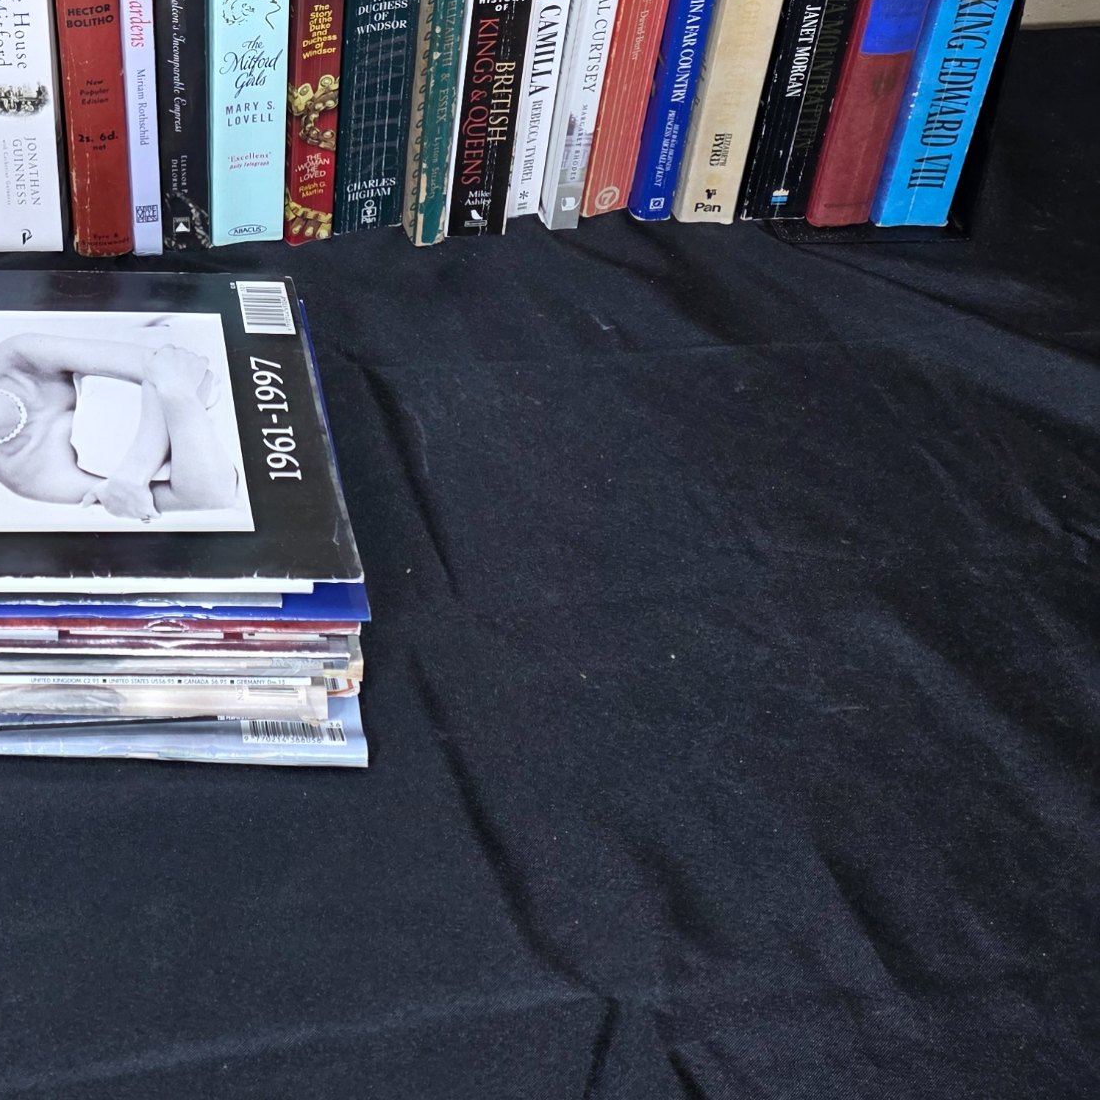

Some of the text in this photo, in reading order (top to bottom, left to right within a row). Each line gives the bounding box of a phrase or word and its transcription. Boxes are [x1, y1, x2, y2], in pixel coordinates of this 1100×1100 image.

[68, 3, 111, 16] HECTOR
[310, 10, 332, 19] Story
[357, 0, 409, 16] DUCHESS
[495, 3, 509, 12] OF
[689, 0, 705, 13] IN
[66, 14, 114, 29] BOLITHO
[373, 11, 389, 22] OF
[686, 14, 701, 24] A
[310, 23, 331, 32] Duke
[312, 29, 328, 38] and
[356, 20, 408, 36] WINDSOR
[443, 0, 457, 68] ELIZABETH
[682, 24, 700, 47] FAR
[12, 12, 31, 69] House
[242, 35, 263, 49] The
[302, 35, 338, 47] Duchess
[302, 47, 336, 60] Windsor
[472, 18, 500, 84] KINGS
[528, 5, 562, 97] CAMILLA
[582, 18, 608, 94] CURTSEY
[785, 4, 822, 98] JANET MORGAN
[219, 48, 284, 78] Mitford
[167, 32, 187, 133] Incomparable Empress
[234, 69, 267, 99] Girls
[670, 49, 695, 104] COUNTRY
[795, 19, 843, 149] MOUNTBATTEN
[471, 89, 487, 103] &
[486, 61, 516, 142] BRITISH
[920, 57, 982, 148] EDWARD
[136, 68, 150, 146] Miriam Rothschild
[225, 100, 276, 116] MARY S.
[227, 113, 274, 127] LOVELL
[526, 99, 543, 144] REBECCA
[664, 109, 676, 138] PRINCESS
[99, 130, 119, 141] 6d.
[570, 104, 589, 180] MARGARET RHODES
[461, 105, 489, 186] QUEENS
[709, 132, 726, 167] BYRD
[297, 158, 331, 172] WOMAN
[306, 153, 322, 161] THE
[12, 139, 27, 206] GUINNESS
[23, 137, 41, 206] JONATHAN
[229, 161, 270, 170] Daily Telegraph
[907, 153, 952, 190] VIII
[299, 170, 326, 183] LOVED
[299, 182, 318, 193] Ralph
[346, 177, 396, 193] CHARLES
[301, 189, 324, 198] Martin
[348, 187, 391, 202] HIGHAM
[468, 190, 490, 199] Mike
[463, 197, 491, 207] Ashley
[694, 201, 722, 213] Pan
[233, 225, 262, 235] ABACUS
